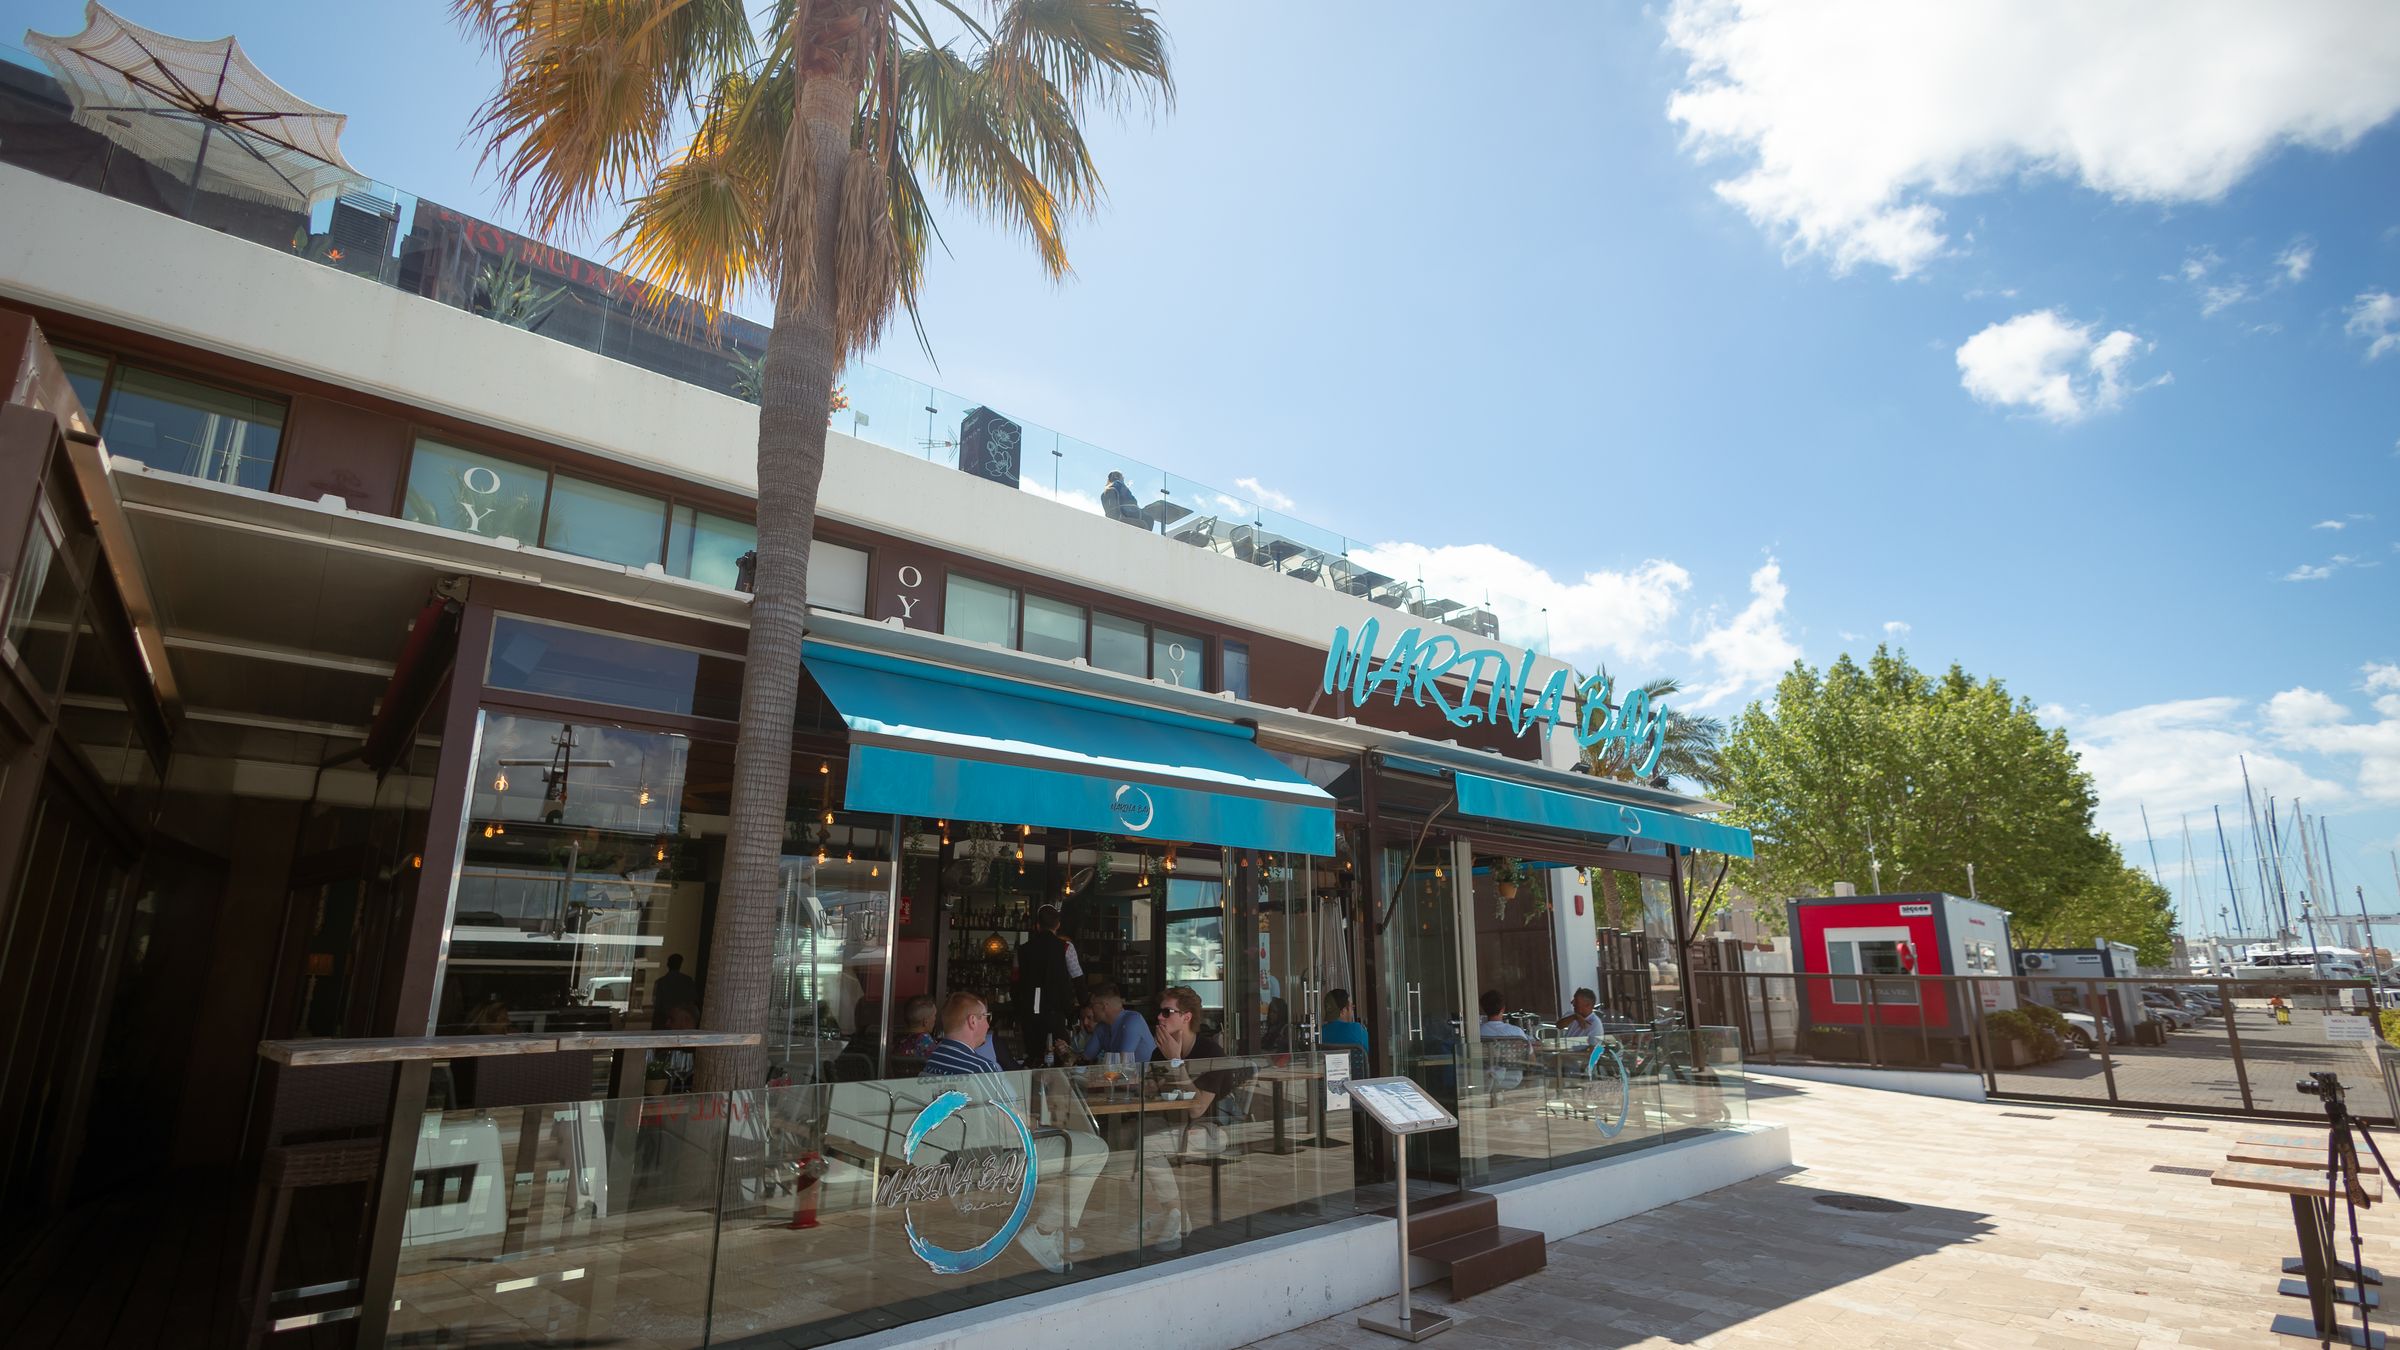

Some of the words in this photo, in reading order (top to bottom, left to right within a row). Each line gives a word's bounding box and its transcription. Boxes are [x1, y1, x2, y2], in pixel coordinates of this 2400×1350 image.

[1323, 616, 1569, 740] MARINA
[1574, 674, 1667, 778] BAY
[875, 1157, 976, 1208] MARINA
[977, 1153, 1028, 1194] BAY
